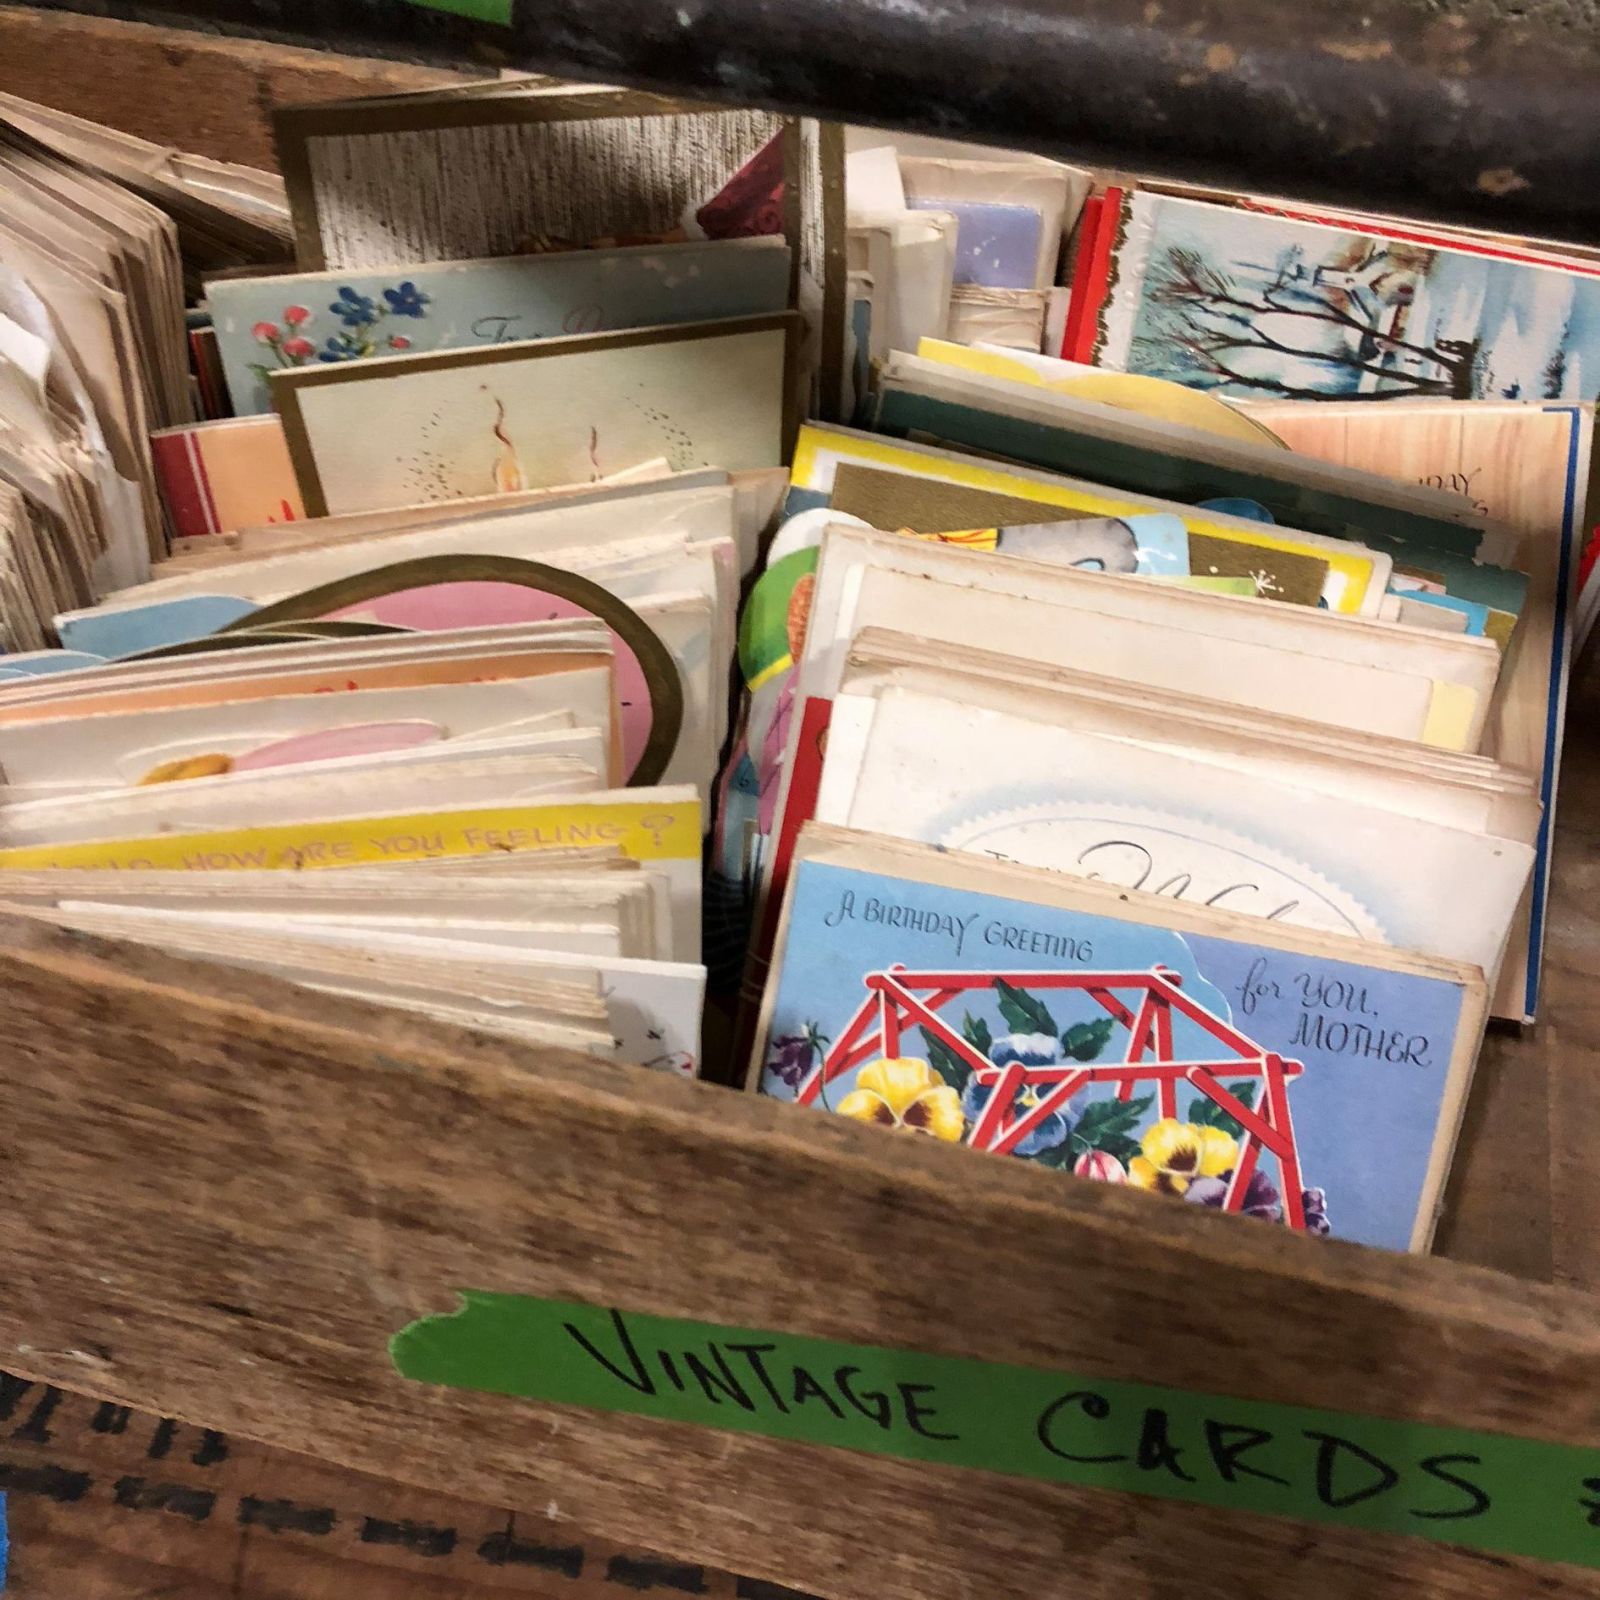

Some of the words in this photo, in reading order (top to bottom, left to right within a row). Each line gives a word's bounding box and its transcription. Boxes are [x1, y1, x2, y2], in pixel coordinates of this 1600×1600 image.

[281, 839, 353, 868] ARE
[370, 833, 444, 855] YOU
[462, 822, 628, 849] FEELING
[824, 889, 856, 927] A
[863, 897, 980, 957] BIRTHDAY
[983, 920, 1094, 963] GREETING
[1235, 957, 1283, 1015] for
[1288, 1012, 1432, 1068] MOTHER
[562, 1307, 961, 1441] VINTAGE
[1036, 1391, 1491, 1520] CARDS
